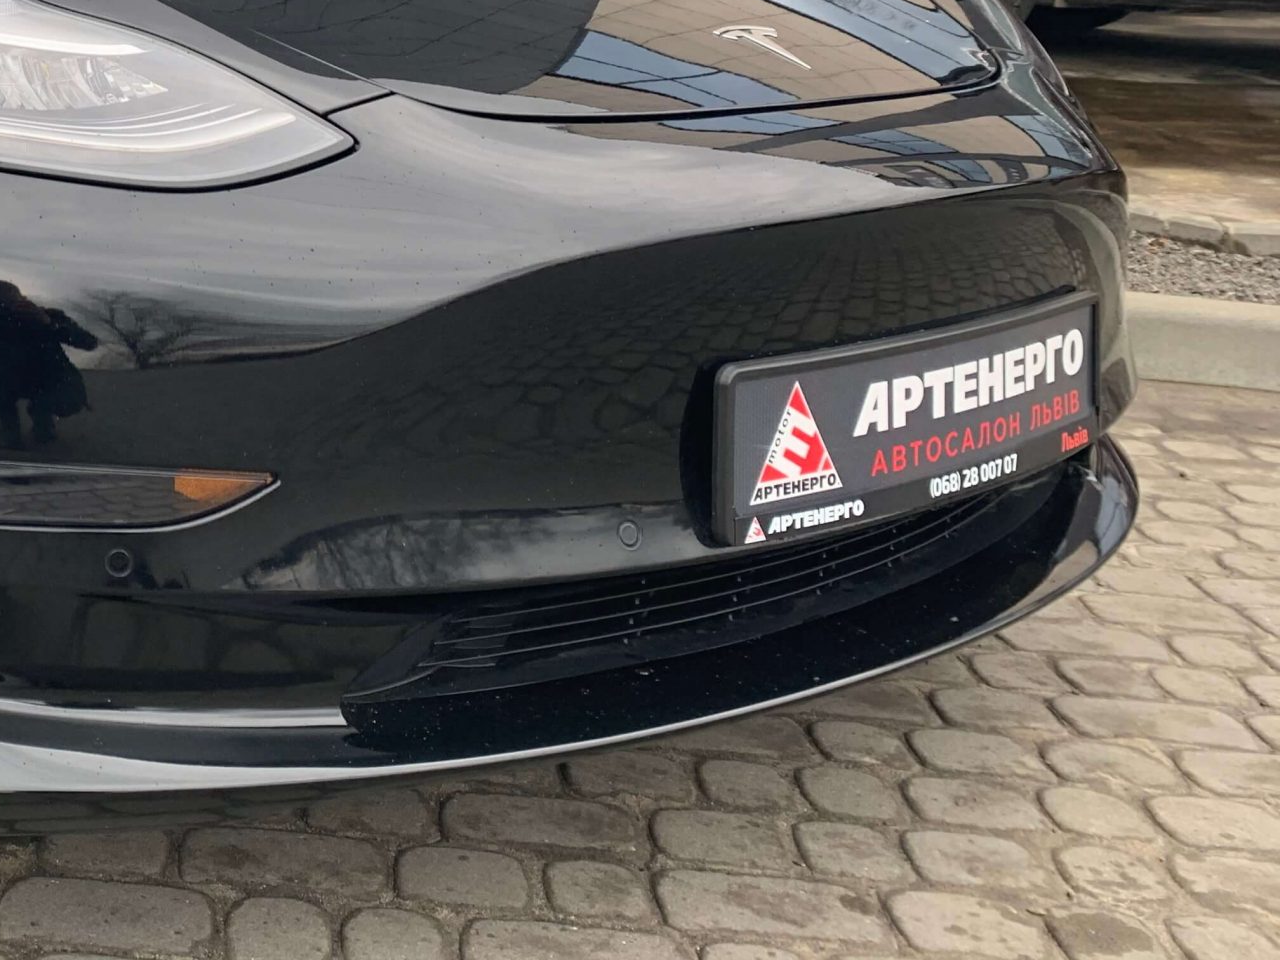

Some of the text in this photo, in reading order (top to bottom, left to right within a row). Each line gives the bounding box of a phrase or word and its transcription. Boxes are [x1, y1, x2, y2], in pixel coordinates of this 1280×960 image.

[853, 328, 1084, 437] АРТЕНЕРГО
[768, 409, 792, 464] motor
[871, 390, 1080, 477] АВТОСАЛОН ЛЬВІВ
[1061, 427, 1089, 453] Львів
[929, 470, 961, 499] (068)
[963, 463, 980, 487] 28
[768, 499, 865, 535] АРТЕНЕРГО
